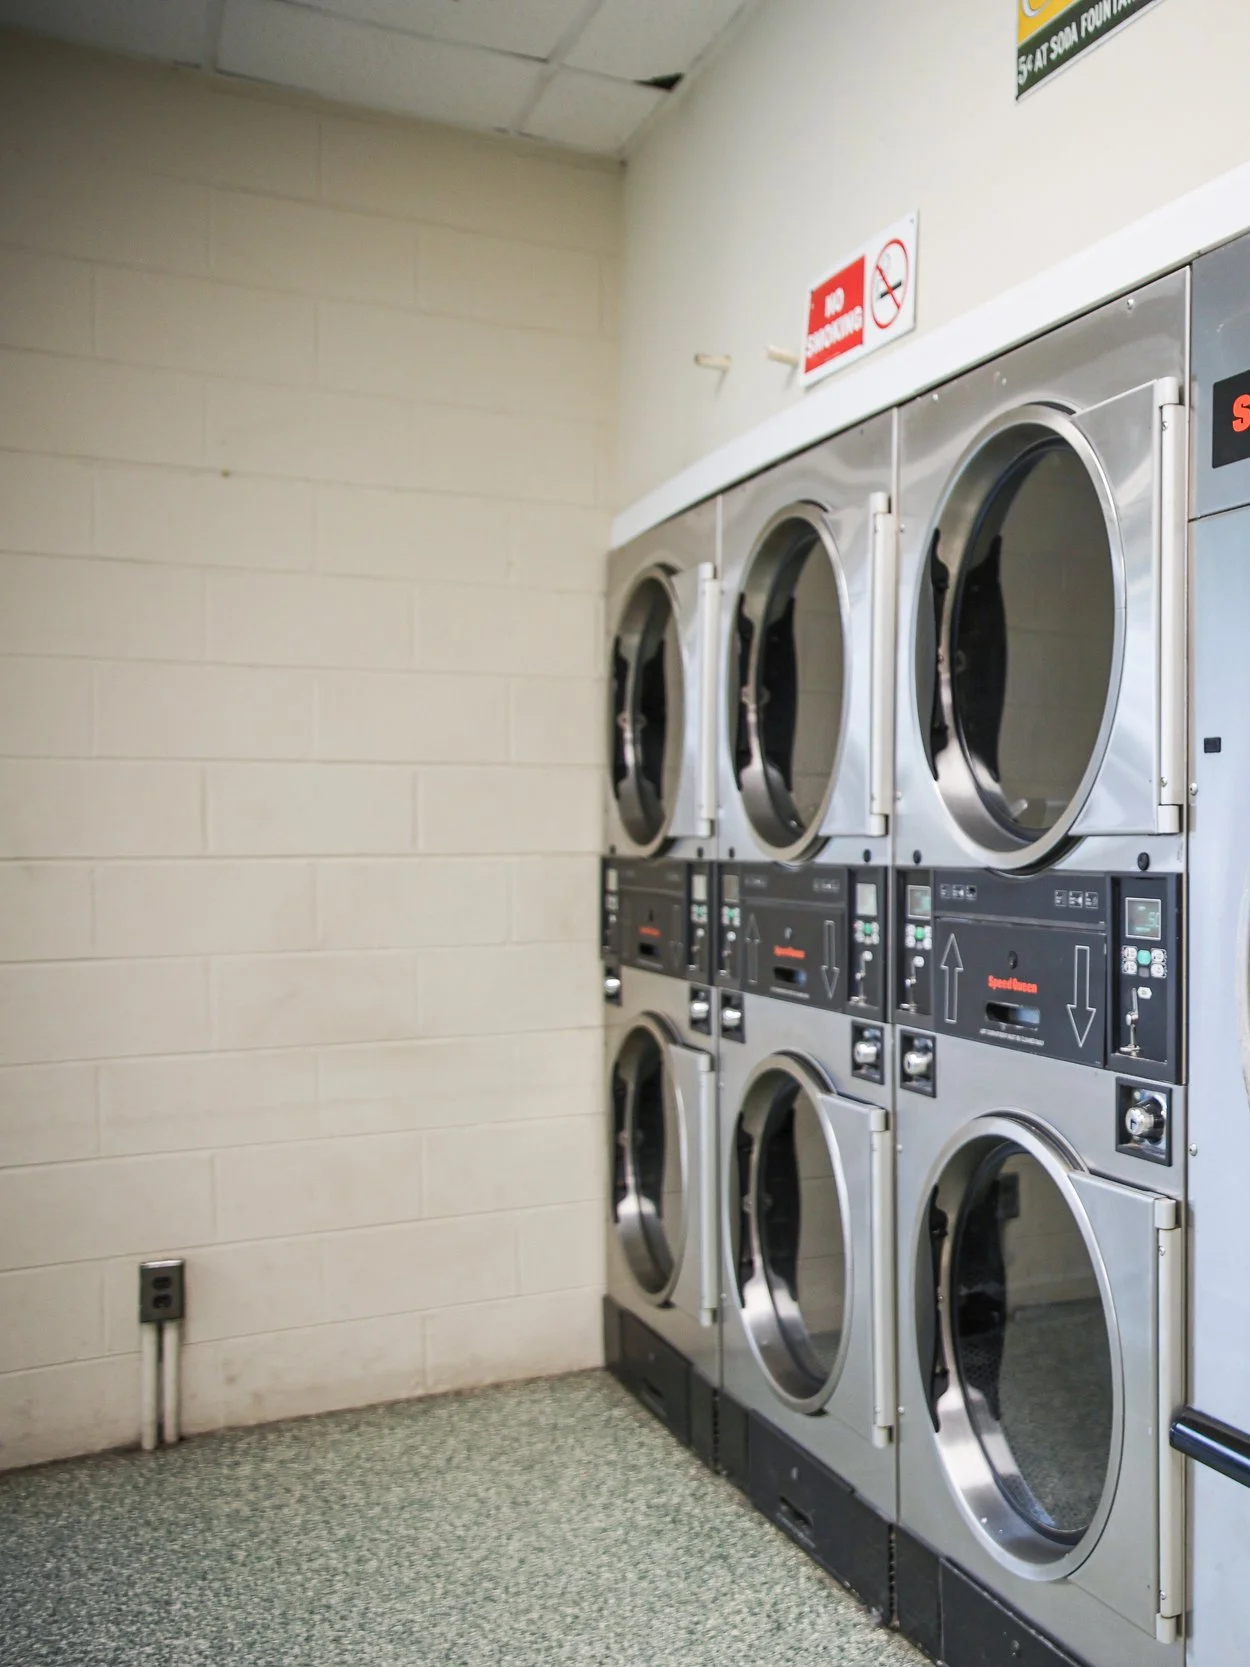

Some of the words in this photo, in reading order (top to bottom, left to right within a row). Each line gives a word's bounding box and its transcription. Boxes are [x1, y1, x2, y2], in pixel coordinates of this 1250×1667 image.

[1034, 42, 1049, 72] AT
[1050, 21, 1079, 60] SODA
[824, 287, 845, 319] NO
